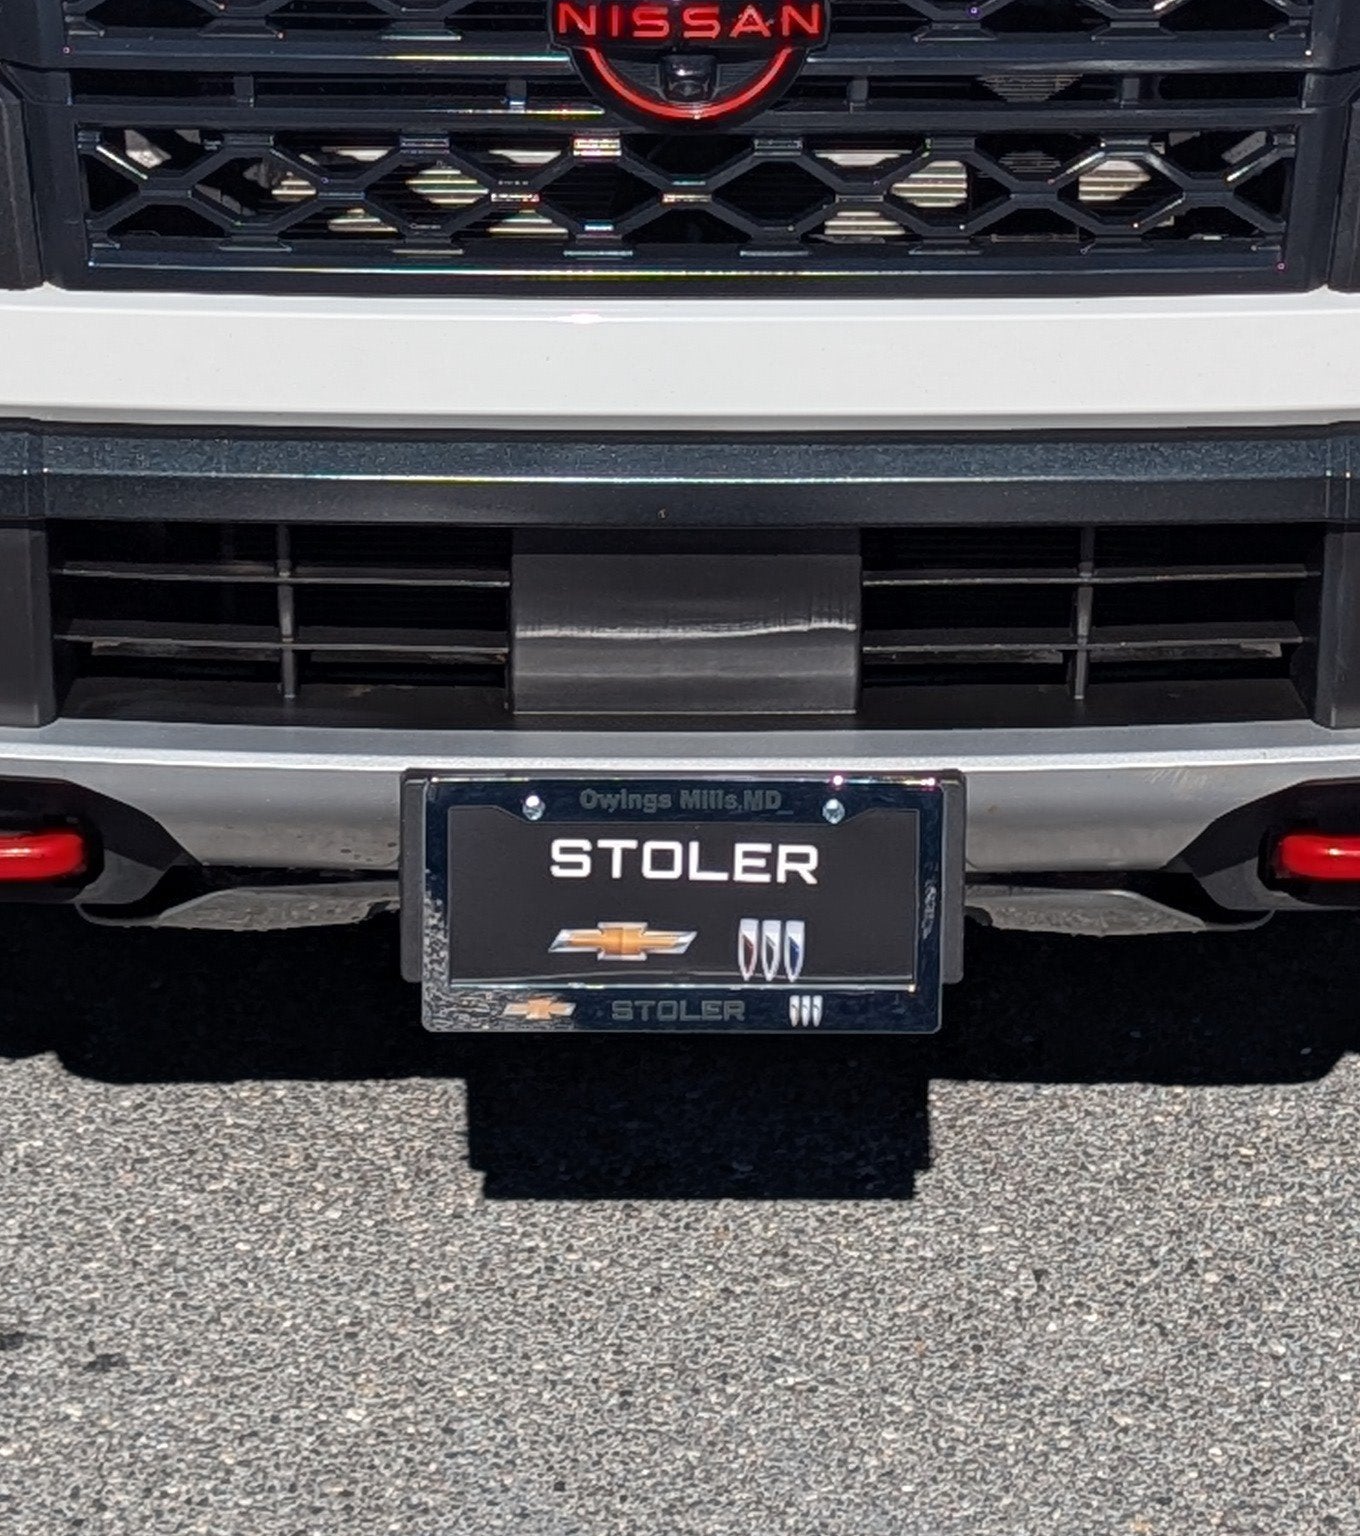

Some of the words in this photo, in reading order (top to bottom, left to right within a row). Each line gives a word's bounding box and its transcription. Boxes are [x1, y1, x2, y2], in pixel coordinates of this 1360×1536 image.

[556, 2, 821, 40] NISSAN
[579, 788, 672, 813] Owings
[549, 838, 819, 884] STOLER
[611, 1000, 745, 1022] STOLER
